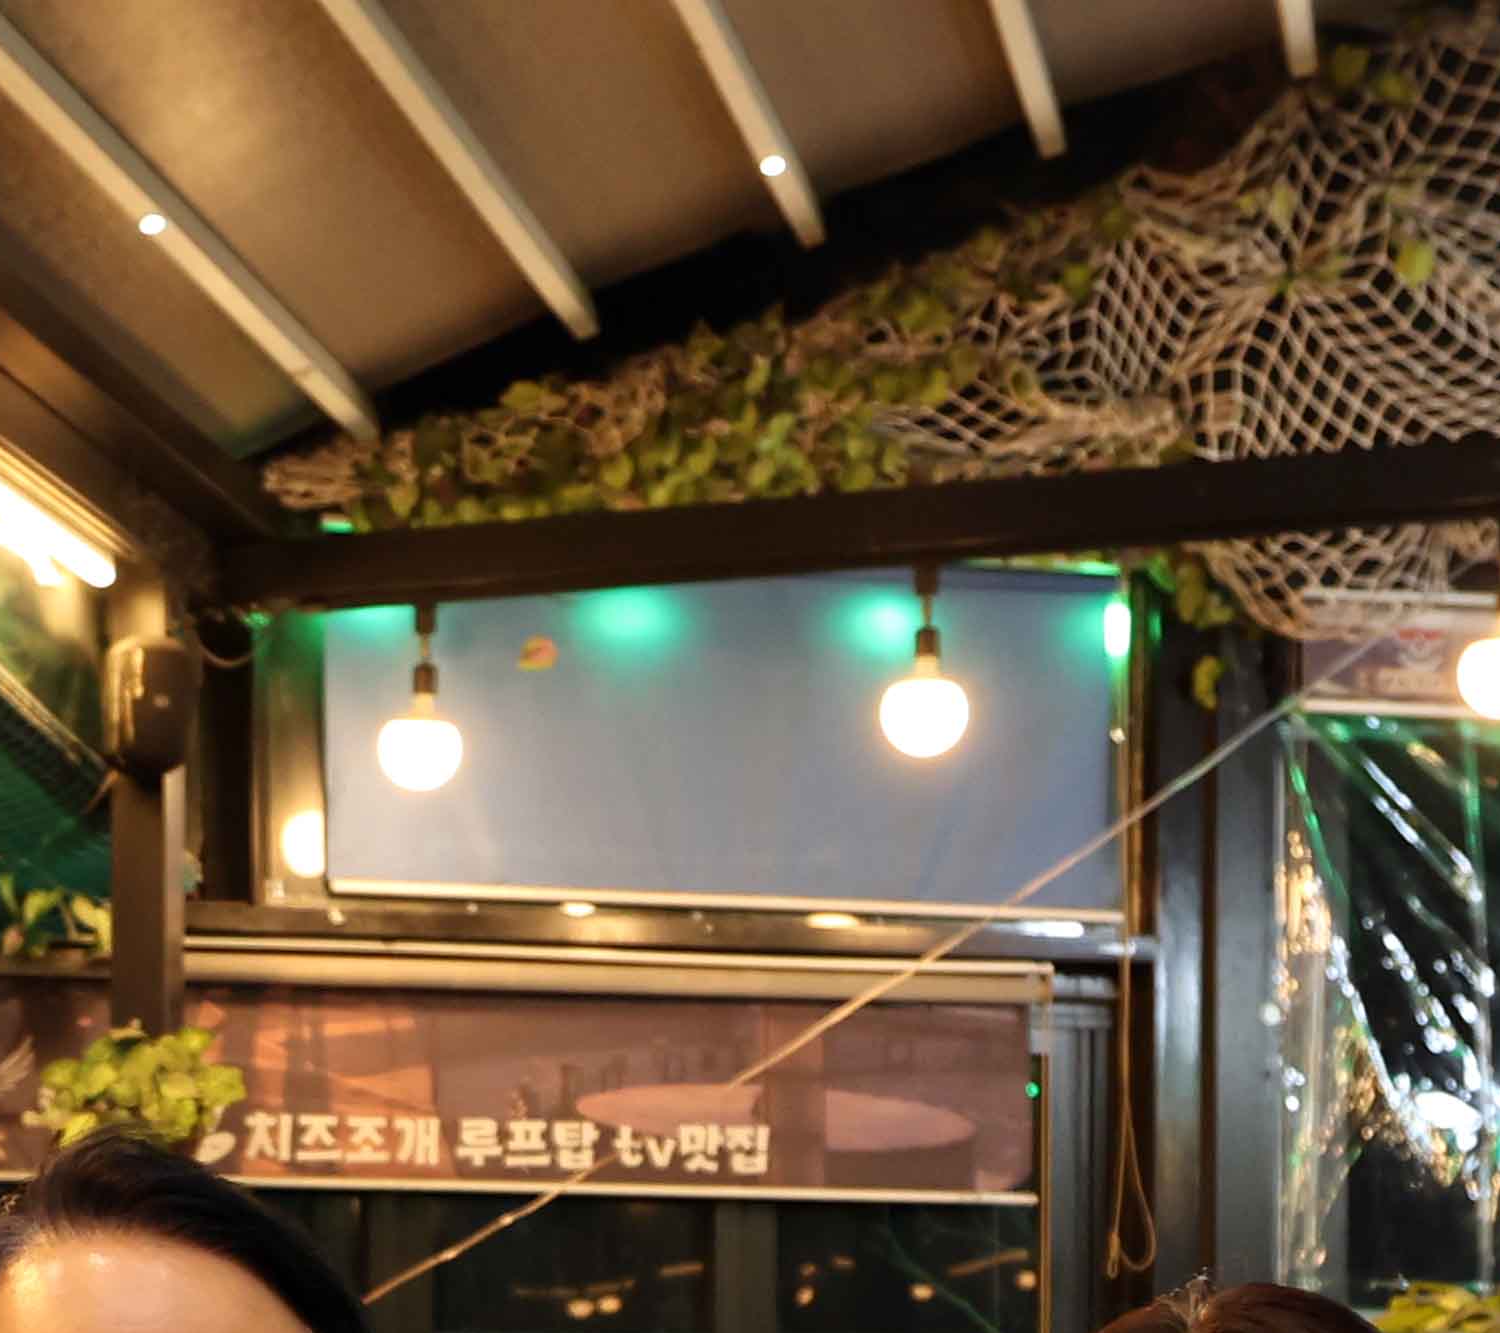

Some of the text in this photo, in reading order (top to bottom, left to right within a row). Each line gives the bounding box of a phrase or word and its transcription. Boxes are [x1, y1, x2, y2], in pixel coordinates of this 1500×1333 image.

[246, 1111, 771, 1176] 치즈조개 루프탑 tv맛집
